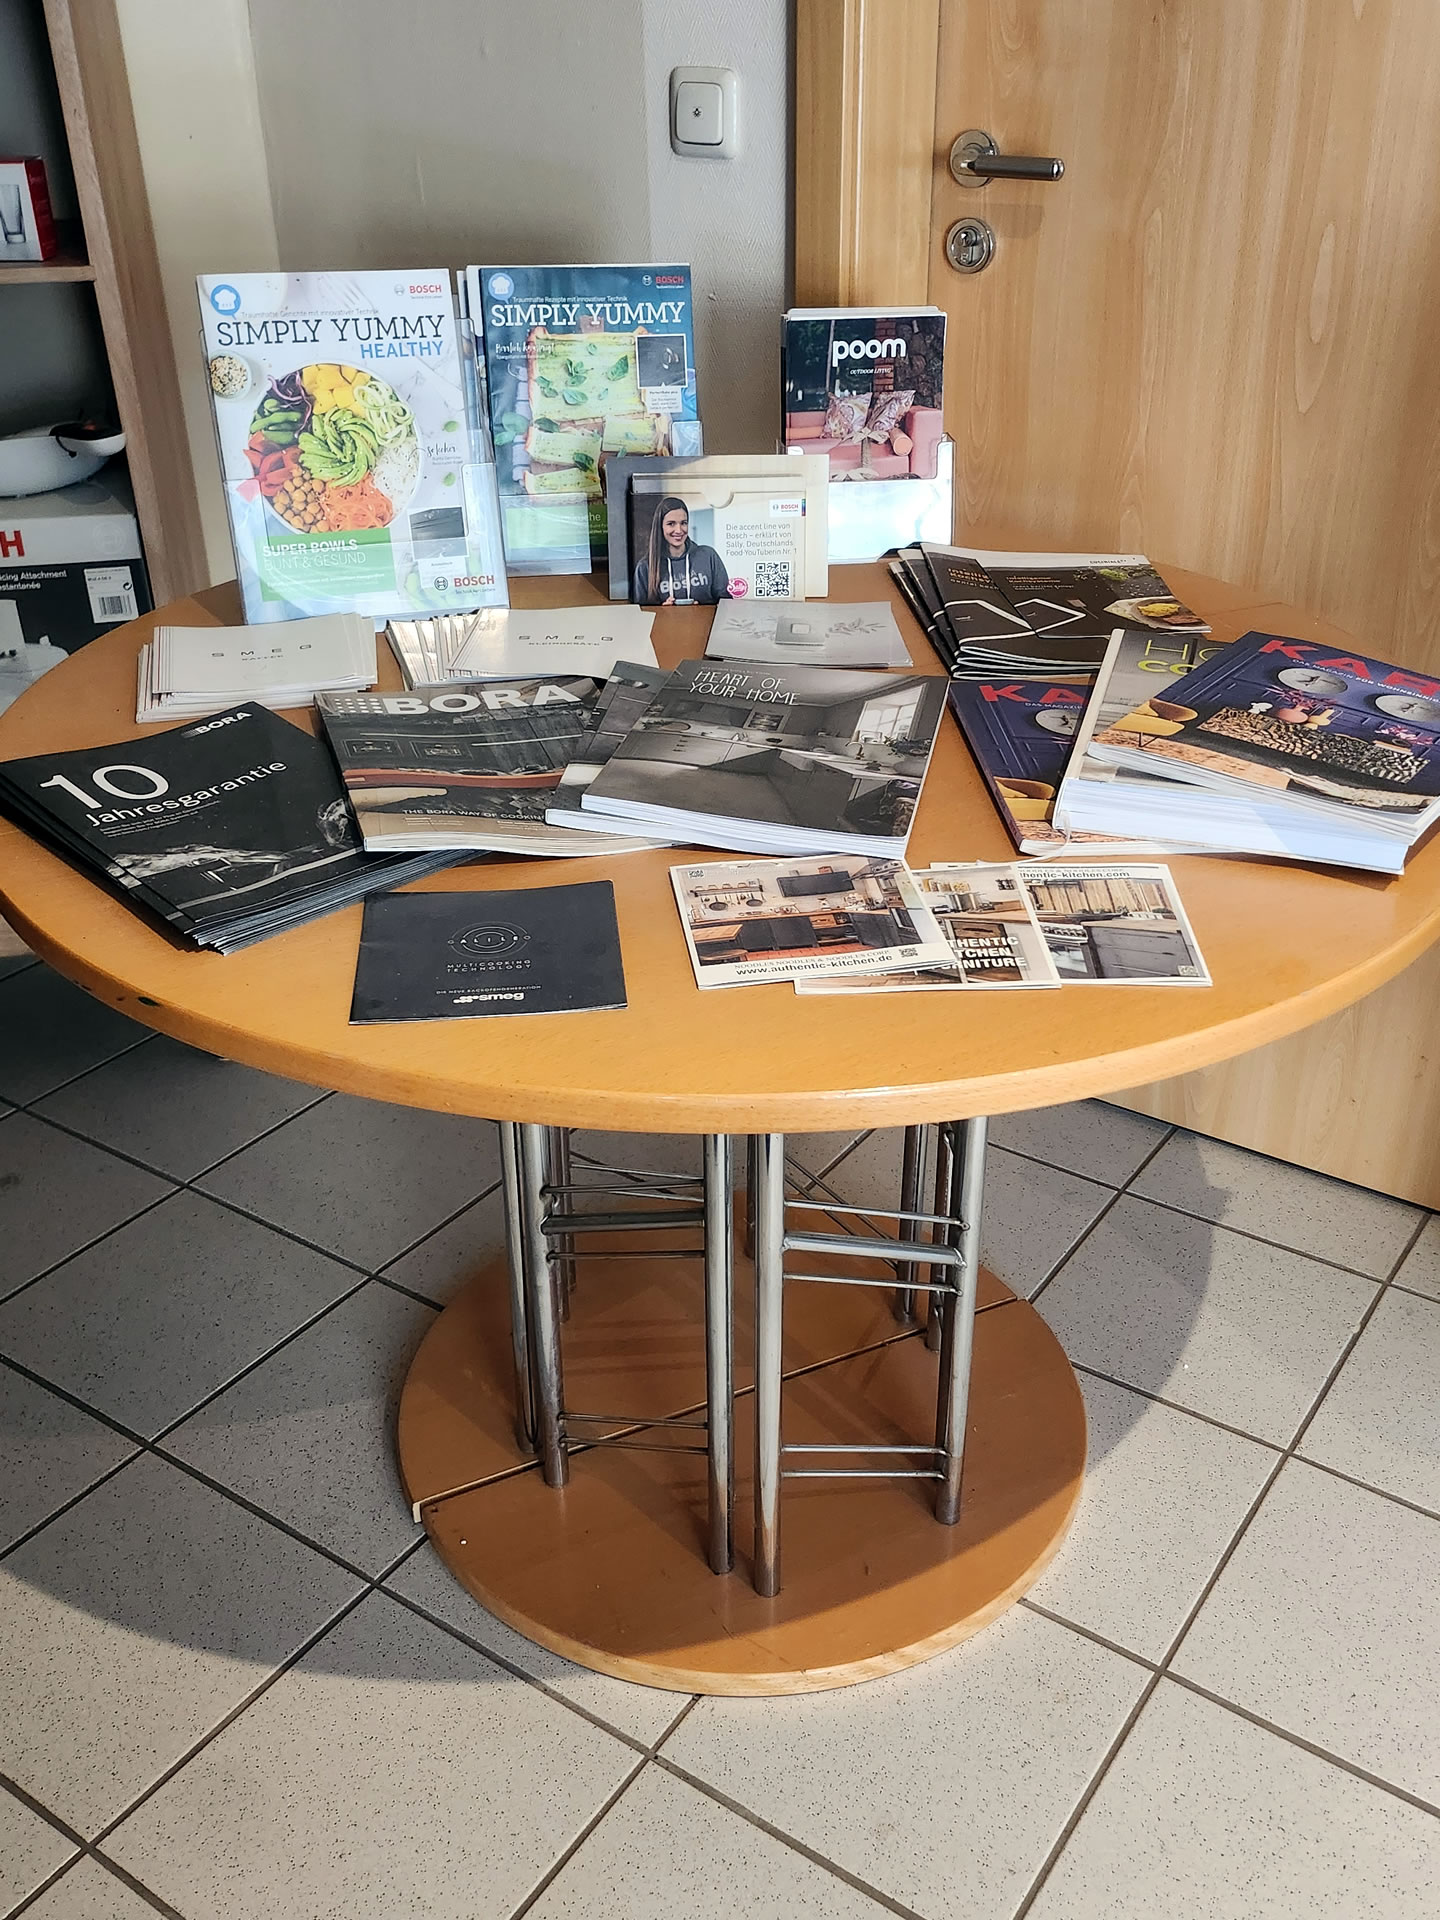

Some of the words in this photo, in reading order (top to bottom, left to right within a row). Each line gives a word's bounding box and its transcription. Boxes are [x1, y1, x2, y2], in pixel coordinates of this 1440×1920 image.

[409, 284, 442, 294] BOSCH
[656, 276, 684, 285] BOSCH
[607, 295, 628, 303] Technik
[491, 303, 579, 327] SIMPLY
[585, 301, 685, 326] YUMMY
[217, 319, 322, 347] SIMPLY
[331, 314, 445, 341] YUMMY
[360, 341, 443, 359] HEALTHY
[832, 338, 906, 367] poom
[726, 532, 748, 540] Bosch
[755, 531, 778, 539] erklärt
[739, 523, 763, 531] accent
[263, 542, 307, 557] SUPER
[310, 538, 358, 554] BOWLS
[746, 539, 794, 548] Deutschlands
[264, 556, 299, 571] BUNT
[302, 556, 312, 569] &
[314, 551, 367, 567] GESUND
[20, 570, 68, 580] Attachment
[453, 575, 495, 588] BOSCH
[660, 573, 708, 594] Bosch
[1259, 639, 1440, 697] KAR
[694, 670, 753, 687] HEART
[761, 677, 787, 690] OF
[1312, 664, 1354, 679] MAGAZIN
[1377, 682, 1440, 704] WOHNSINNIG
[381, 684, 582, 715] BORA
[690, 681, 737, 698] YOUR
[745, 688, 800, 705] HOME
[979, 684, 1085, 704] KA
[194, 711, 252, 735] BORA
[40, 764, 169, 810] 10
[86, 760, 288, 828] Jahresgarantie
[946, 936, 1019, 949] THENTIC
[734, 960, 775, 969] NOODLES
[775, 957, 816, 965] NOODLES
[825, 953, 866, 962] NOODLES
[953, 947, 1012, 958] TCHEN
[447, 960, 531, 969] MULTICOOKING
[447, 964, 531, 973] TECHNOLOGY
[736, 954, 893, 975] www.authentic-kitchen.de
[479, 992, 524, 1001] smeg
